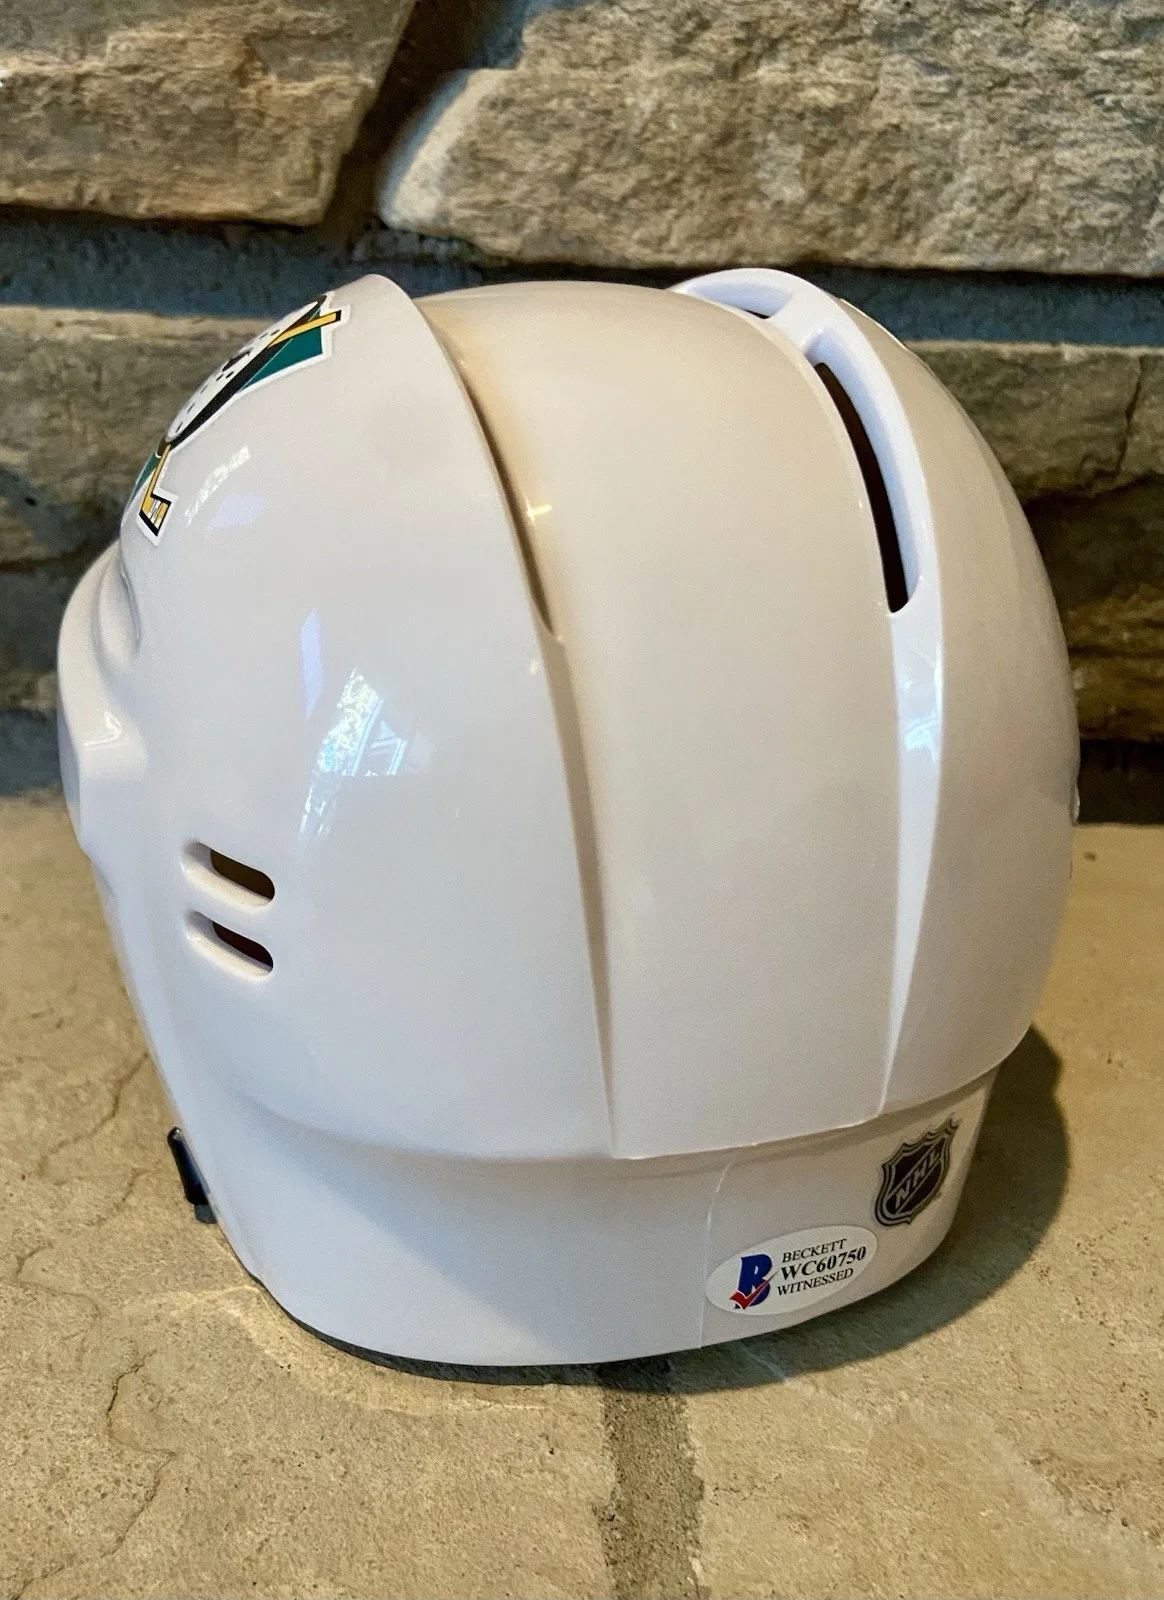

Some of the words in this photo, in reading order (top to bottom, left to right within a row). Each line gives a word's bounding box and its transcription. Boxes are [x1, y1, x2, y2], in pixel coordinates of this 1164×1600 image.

[894, 1149, 940, 1210] NHL
[781, 1246, 867, 1281] WC60750
[782, 1238, 847, 1263] BECKETT
[777, 1267, 854, 1296] WITNESSED
